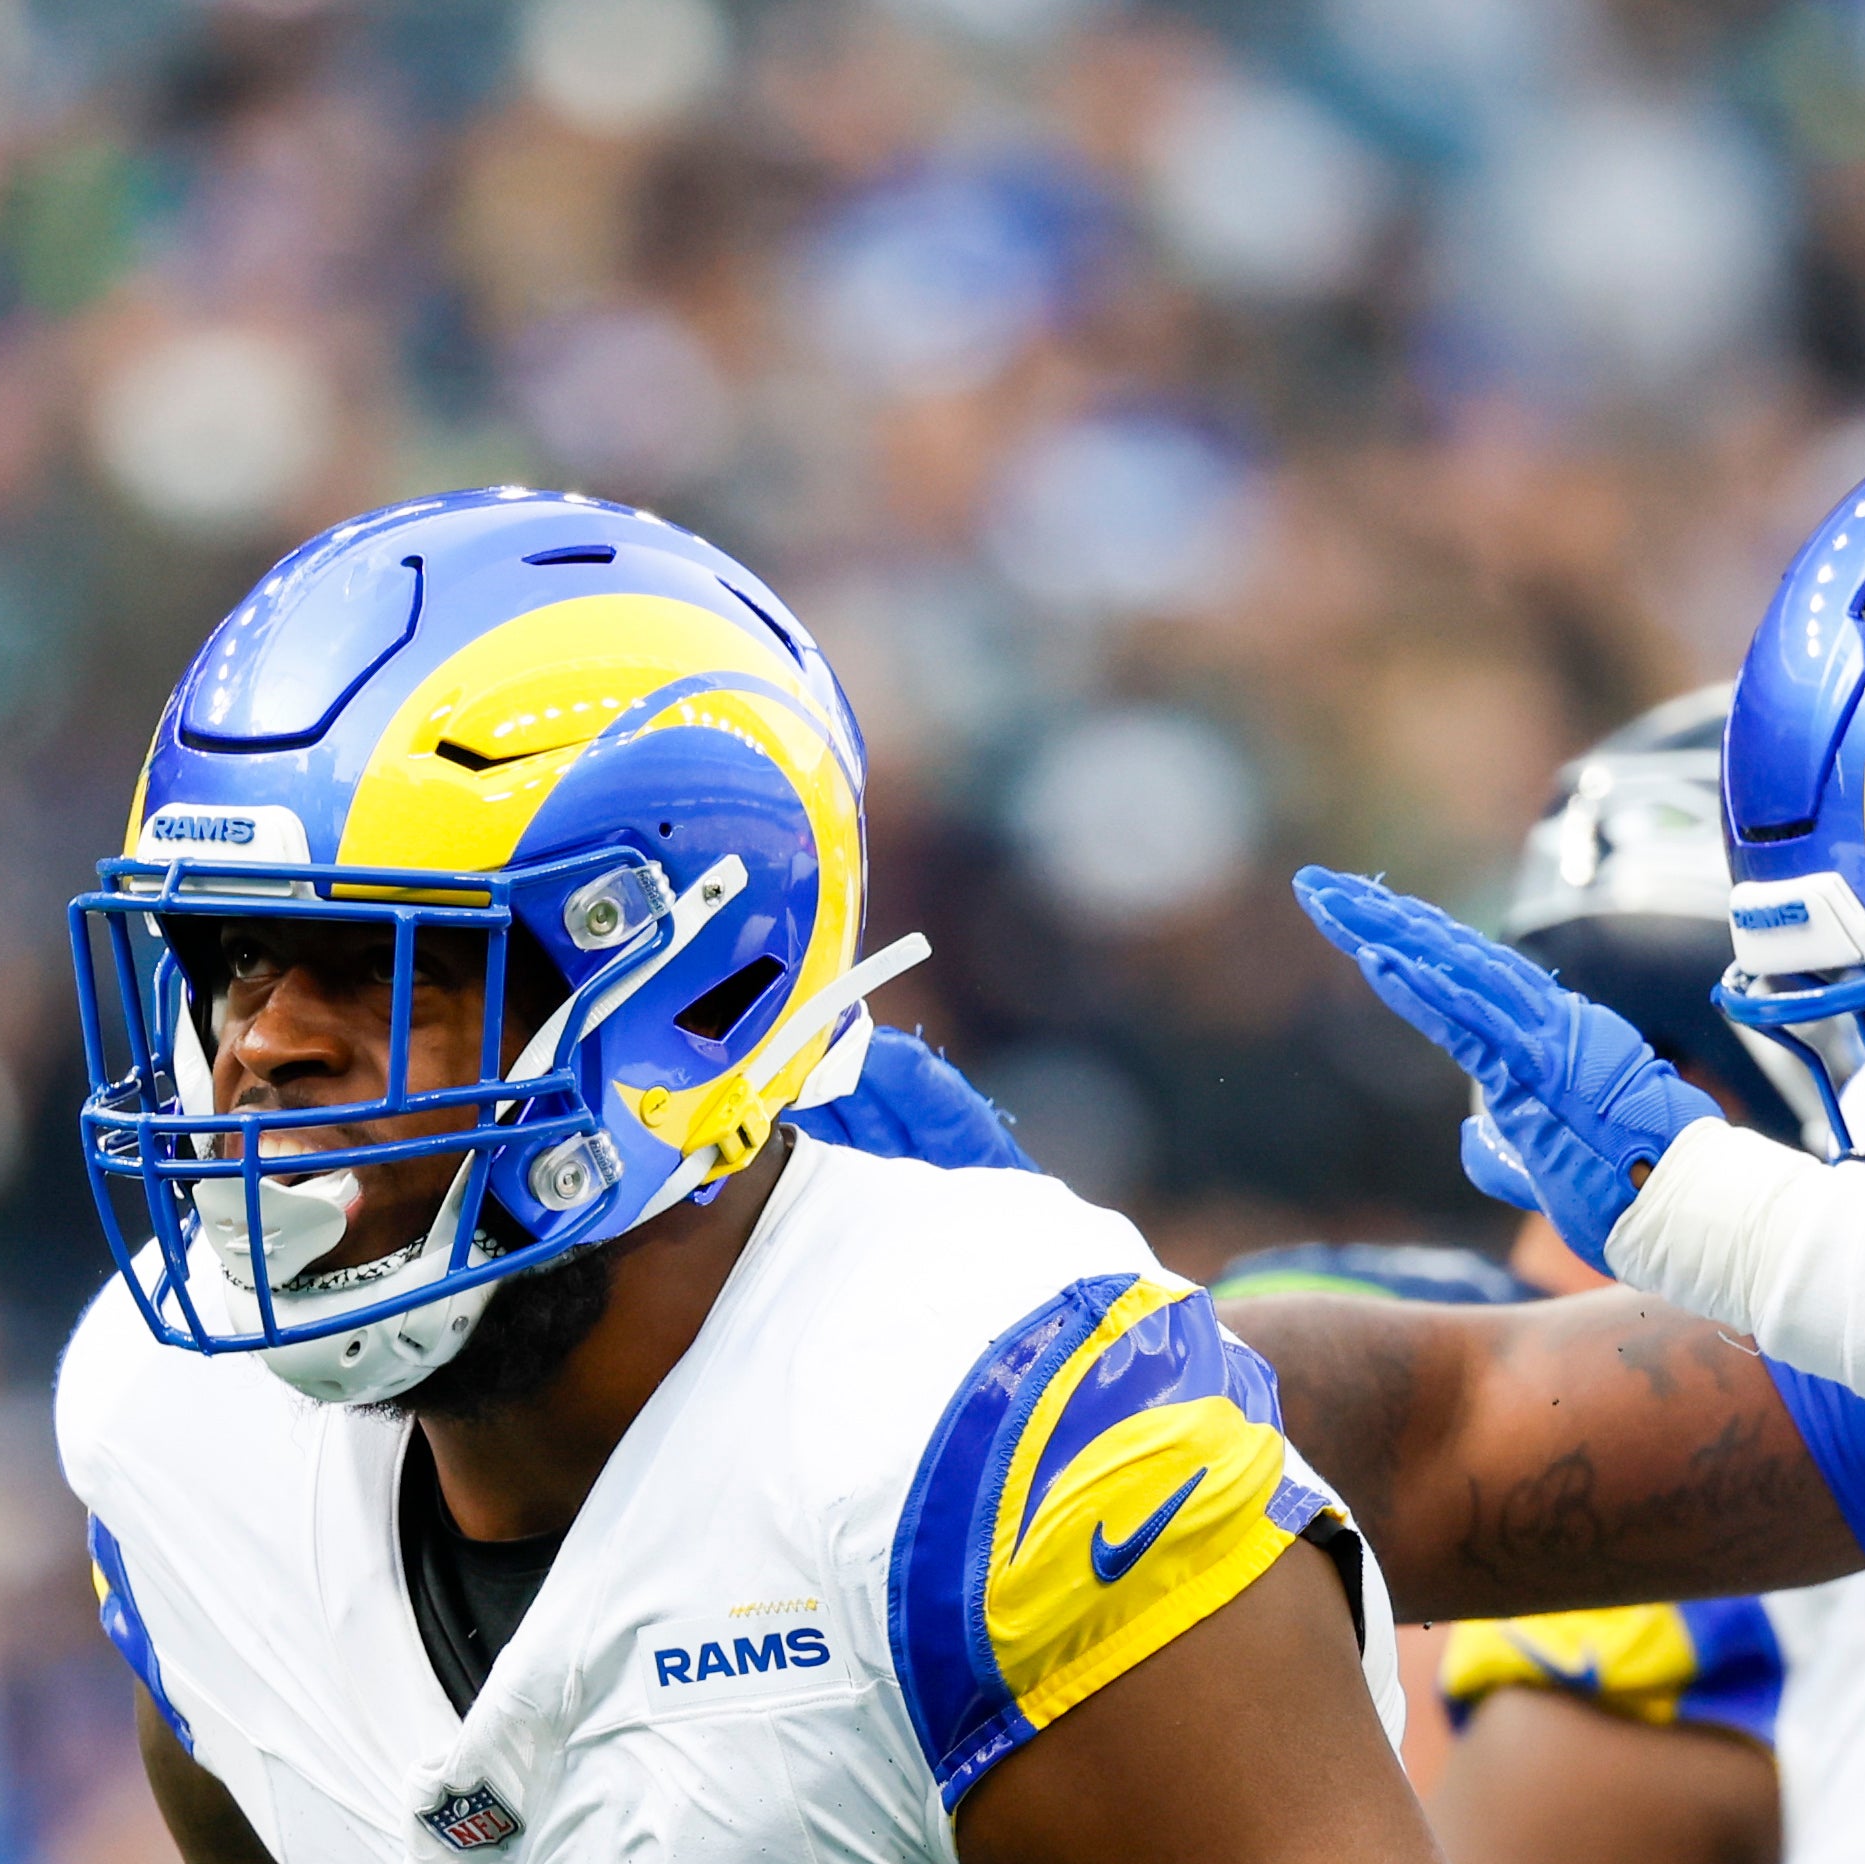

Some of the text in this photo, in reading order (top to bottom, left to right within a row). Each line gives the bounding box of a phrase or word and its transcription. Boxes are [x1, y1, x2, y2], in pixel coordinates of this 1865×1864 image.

[152, 815, 256, 845] RAMS
[653, 1626, 831, 1688] RAMS
[448, 1809, 512, 1848] NFL
